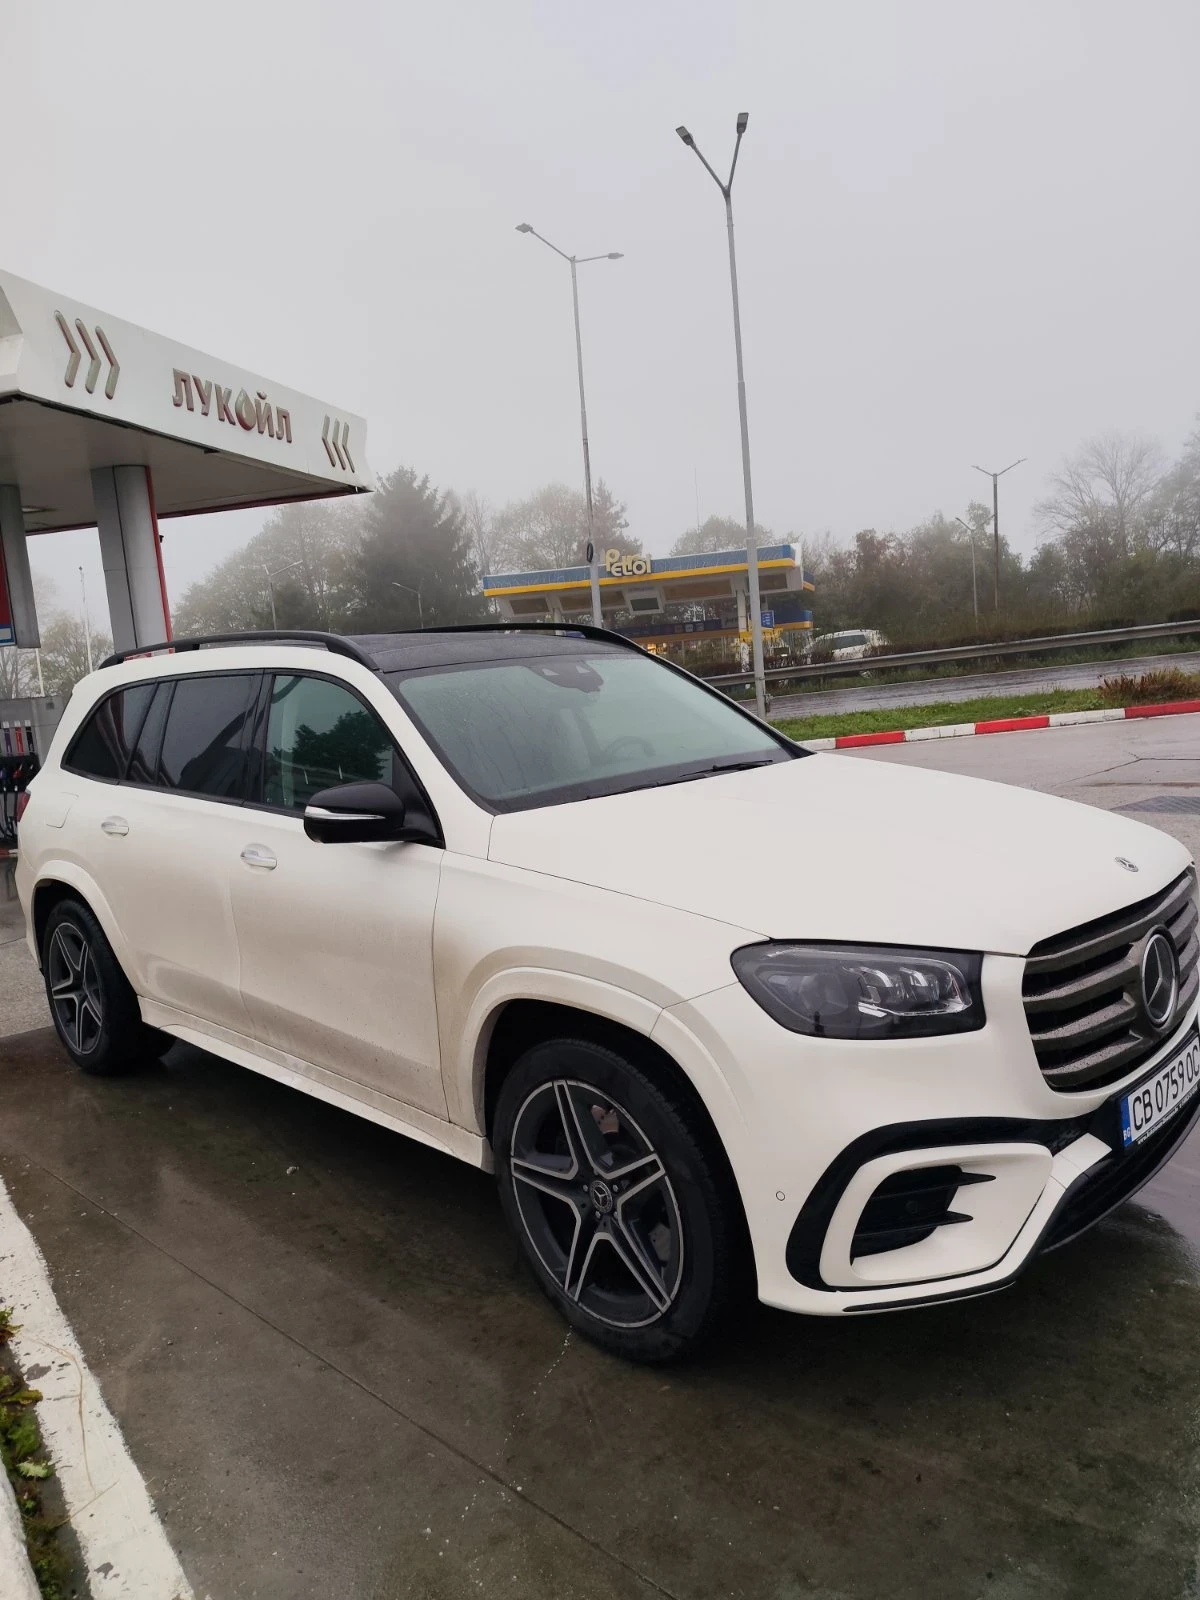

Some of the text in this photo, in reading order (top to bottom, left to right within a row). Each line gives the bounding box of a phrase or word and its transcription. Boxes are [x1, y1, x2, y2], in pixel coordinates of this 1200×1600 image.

[172, 367, 292, 444] ЛУКОЙЛ
[1132, 1088, 1153, 1131] CB
[1155, 1060, 1185, 1113] 0759
[1123, 1126, 1131, 1141] BG
